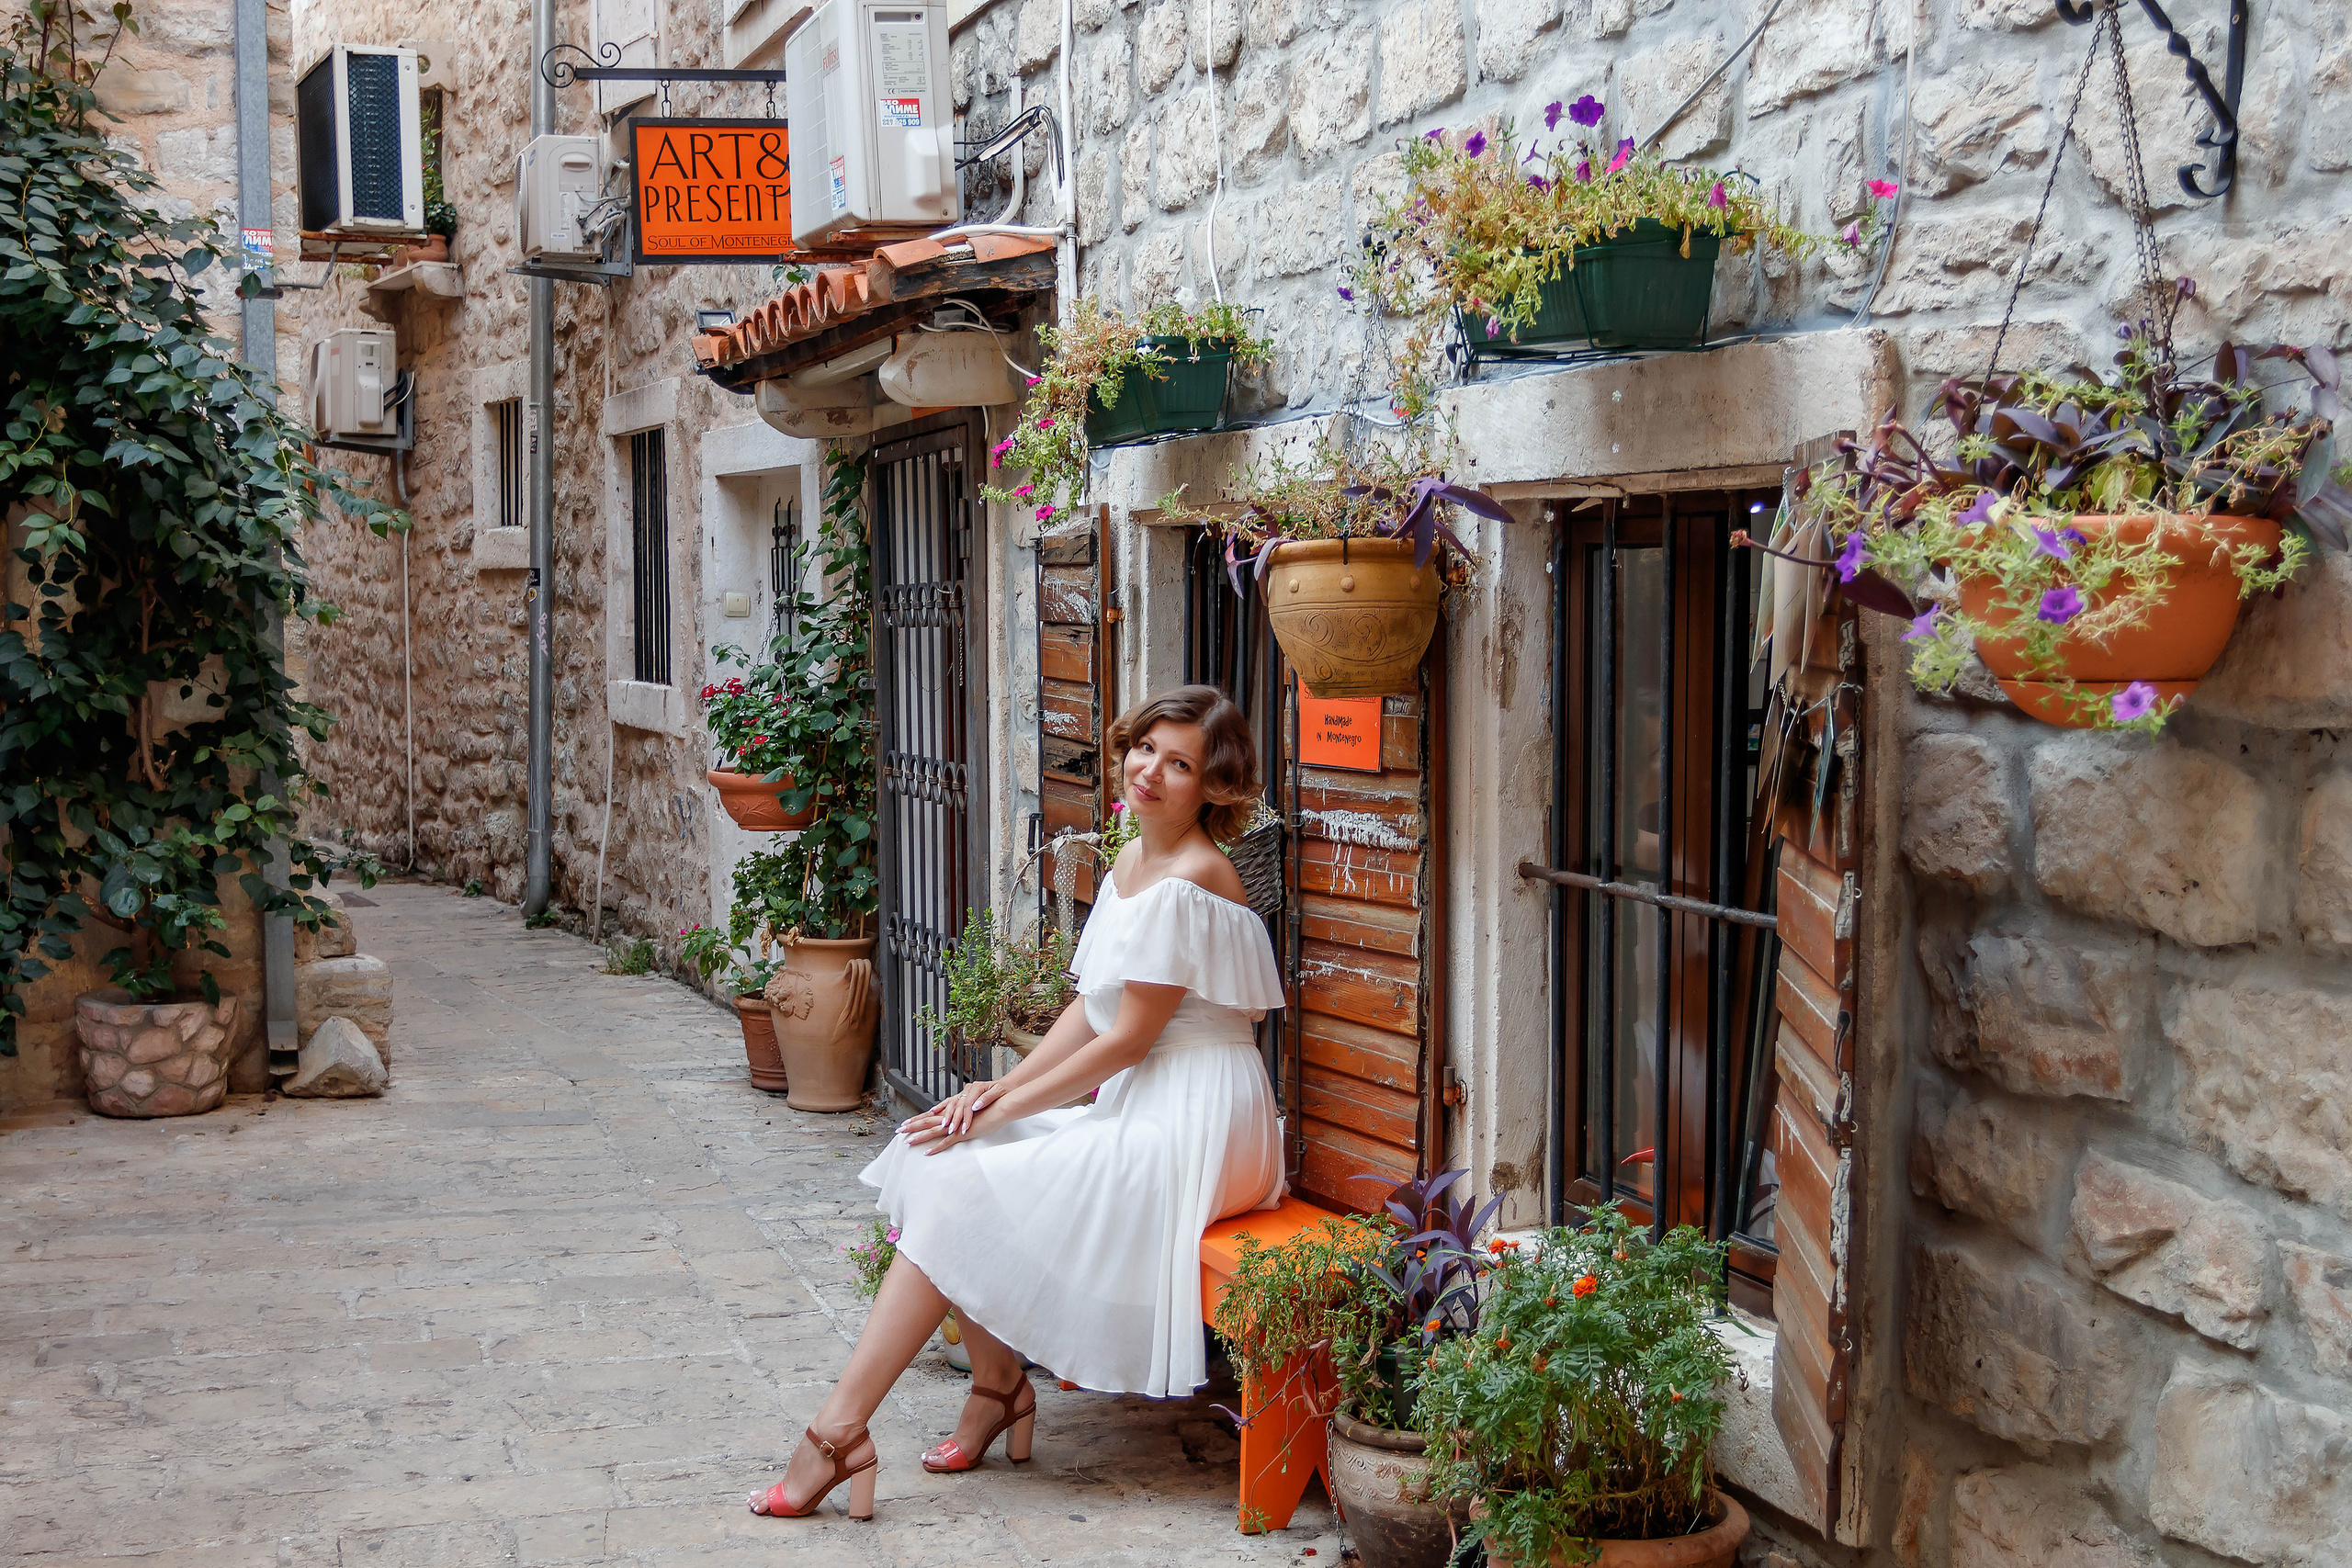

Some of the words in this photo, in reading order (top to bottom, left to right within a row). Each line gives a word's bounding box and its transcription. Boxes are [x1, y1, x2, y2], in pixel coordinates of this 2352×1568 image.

[649, 131, 792, 180] ART&
[644, 184, 792, 223] PRESENT
[711, 234, 797, 249] MONTENEGR
